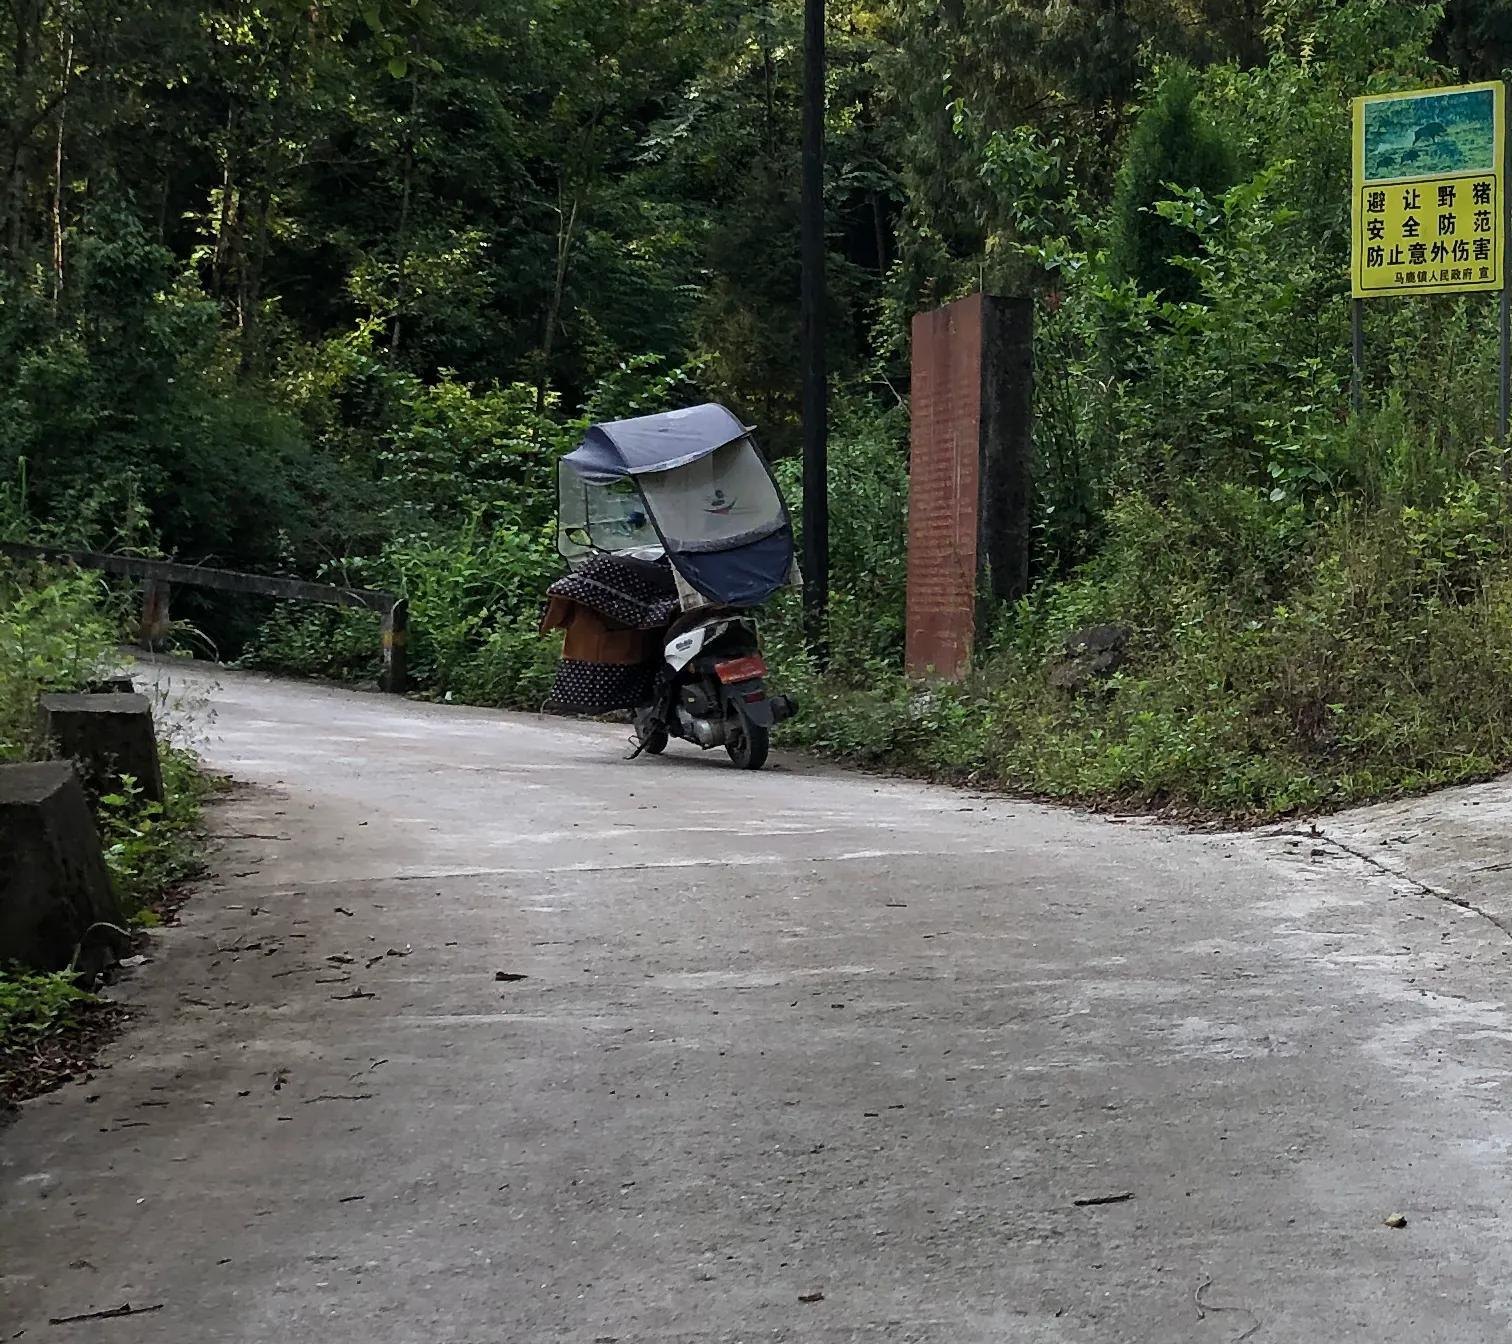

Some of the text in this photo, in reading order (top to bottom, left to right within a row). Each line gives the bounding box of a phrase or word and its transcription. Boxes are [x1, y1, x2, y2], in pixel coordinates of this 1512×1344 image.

[1366, 182, 1491, 213] 避让野猪
[1366, 210, 1491, 241] 安全防范
[1366, 237, 1490, 268] 防止意外伤害
